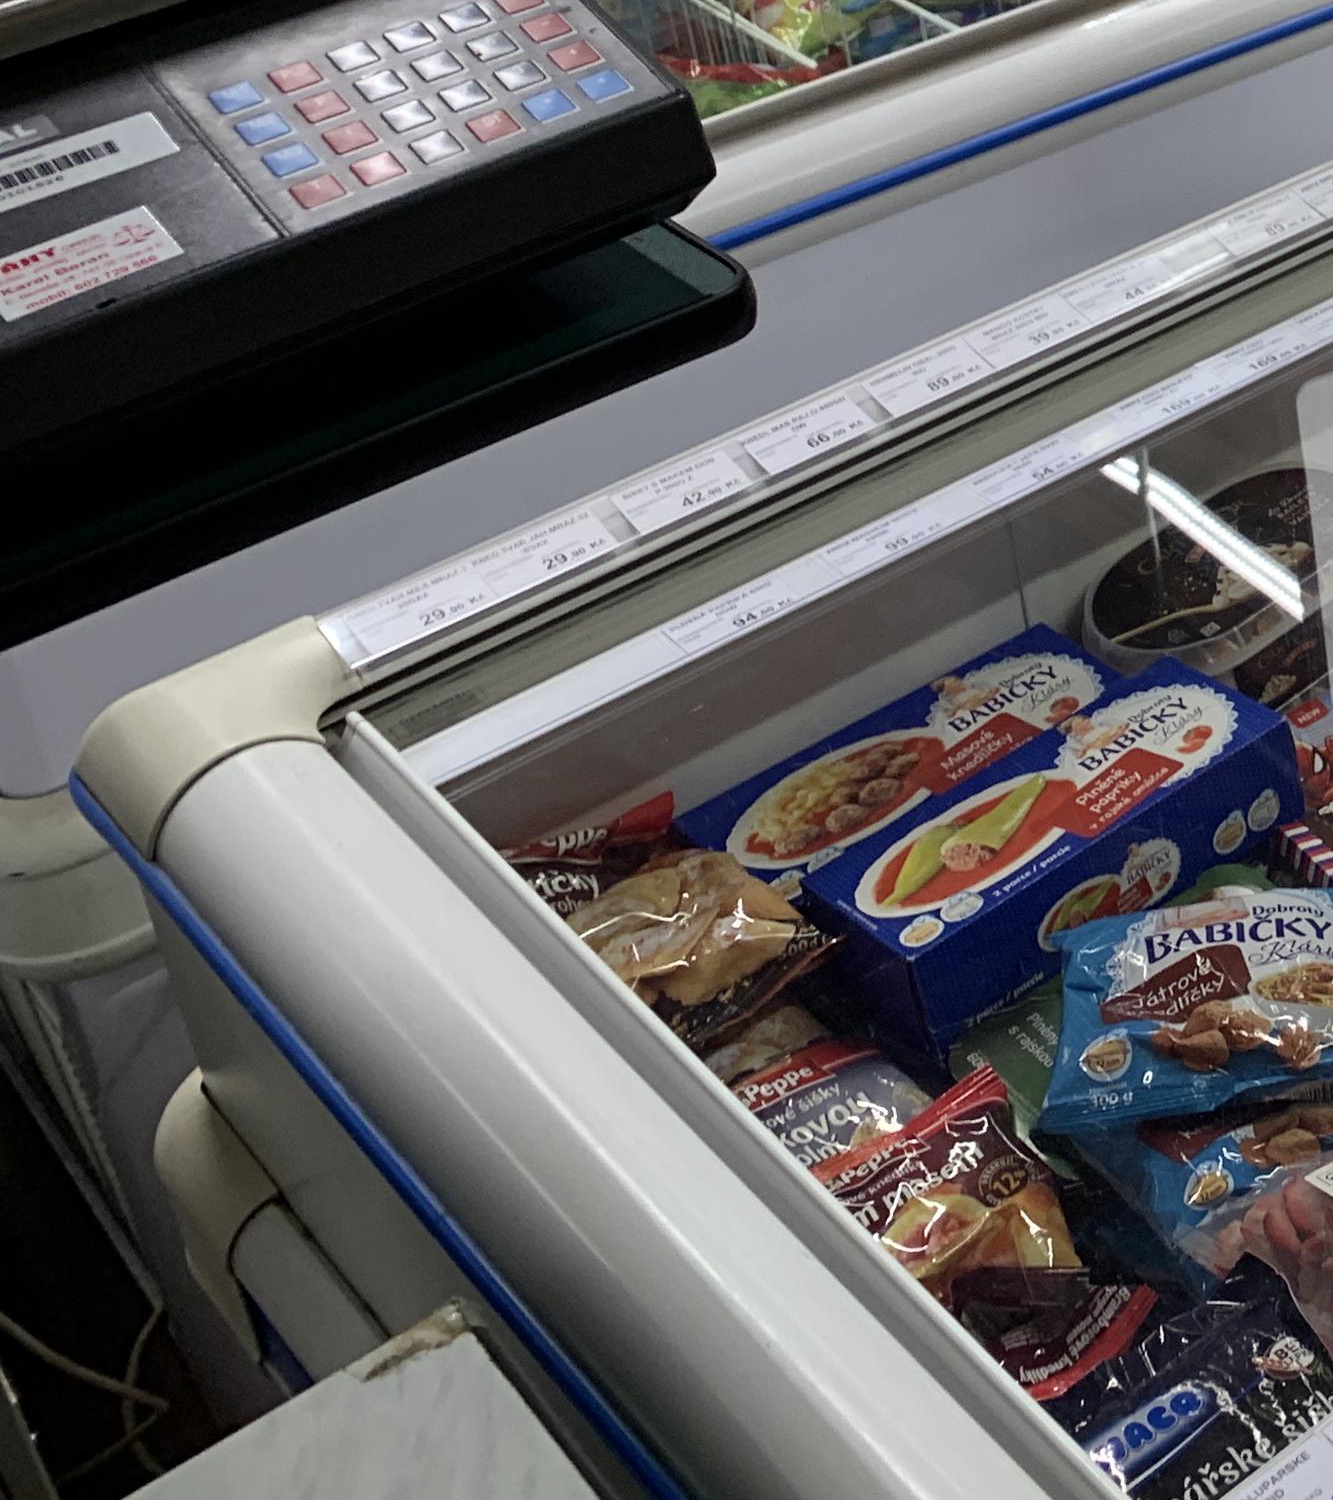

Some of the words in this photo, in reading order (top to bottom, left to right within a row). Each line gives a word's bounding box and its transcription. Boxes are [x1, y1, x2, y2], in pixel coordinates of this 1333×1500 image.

[947, 663, 1058, 733] BABIČKY
[1298, 706, 1321, 724] NEW
[940, 729, 995, 771] Masové
[947, 731, 1014, 782] knedlíčky
[1078, 696, 1189, 772] BABIČKY
[1074, 767, 1126, 807] Plněné
[1089, 770, 1142, 815] papriky
[1099, 794, 1132, 824] rajské
[1001, 871, 1031, 894] porce
[1039, 844, 1072, 867] porcie
[1251, 903, 1325, 922] Dobroty
[1144, 914, 1333, 964] BABIČKY
